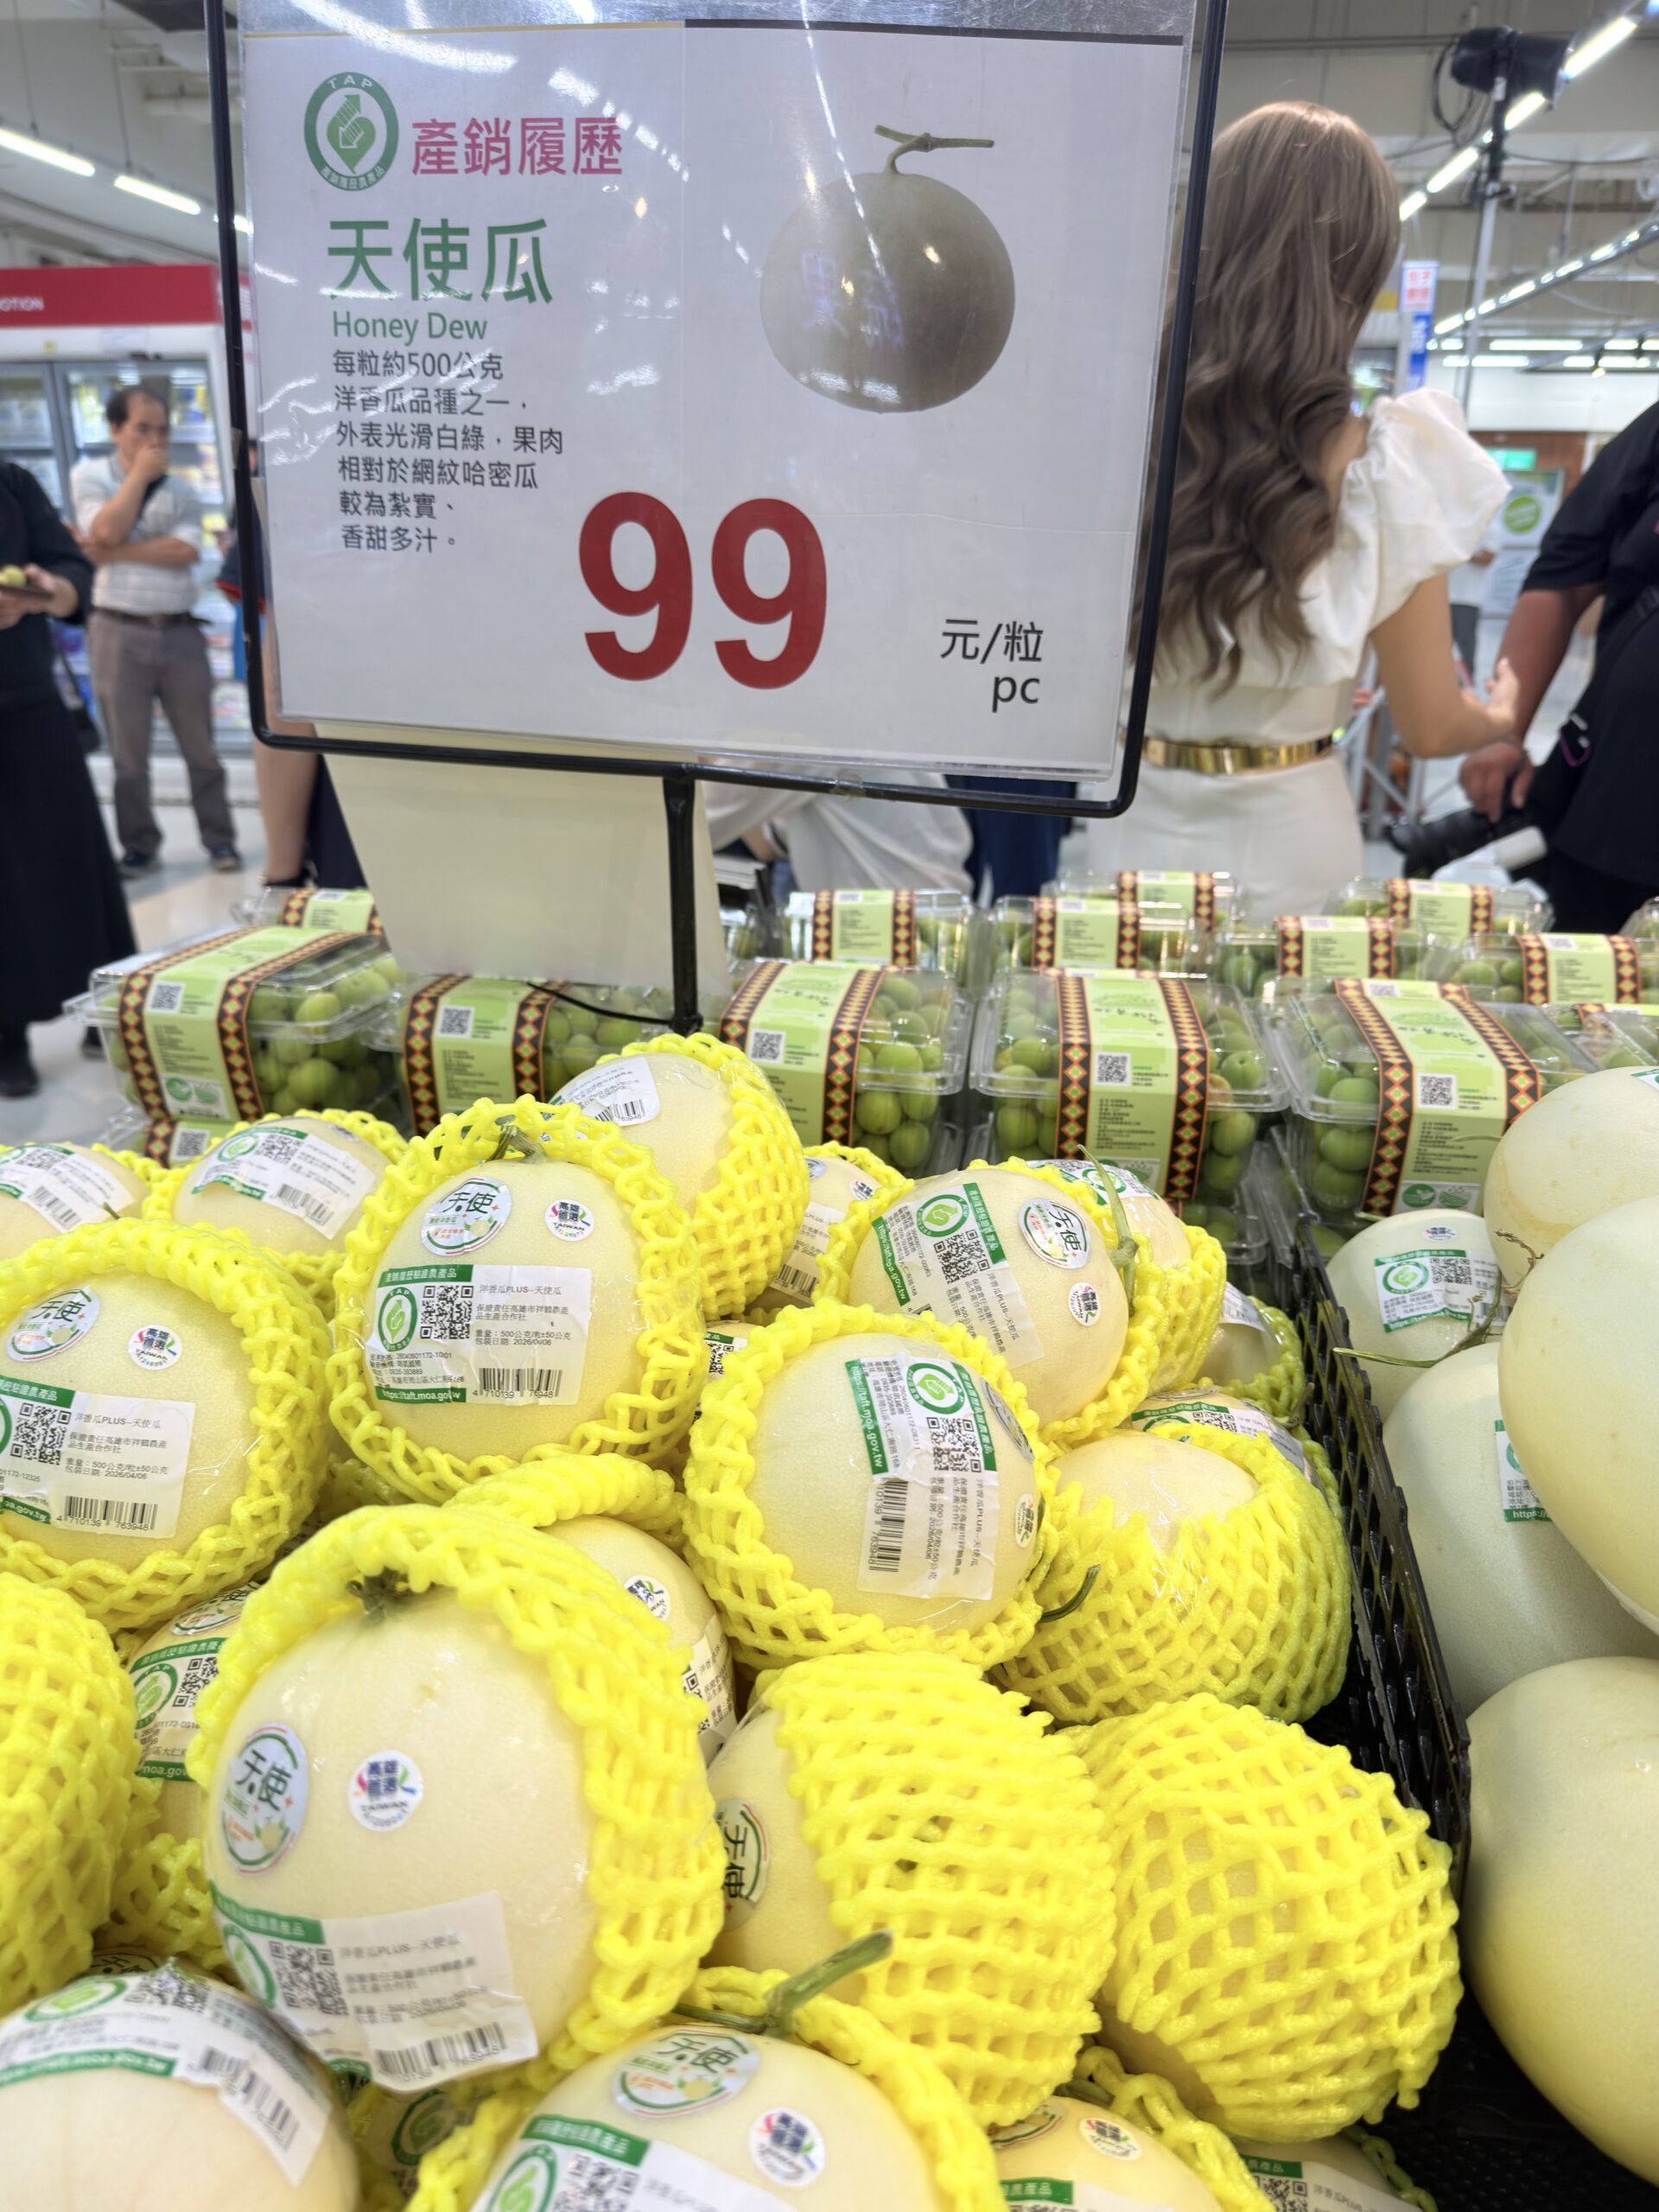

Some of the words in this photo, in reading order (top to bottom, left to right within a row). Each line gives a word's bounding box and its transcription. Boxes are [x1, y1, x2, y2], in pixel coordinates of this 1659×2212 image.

[327, 74, 373, 89] TAP
[411, 117, 623, 175] 產銷履歷
[327, 218, 553, 304] 天使瓜
[333, 311, 418, 346] Honey
[427, 312, 488, 340] Dew
[333, 349, 504, 380] 每粒約500公克
[336, 421, 563, 455] 外表光滑白綠，果肉
[338, 455, 538, 489] 相對於網紋哈密瓜
[341, 524, 455, 553] 香甜多汁。
[578, 492, 827, 690] 99
[940, 619, 1044, 664] 元/粒
[991, 676, 1040, 713] pc
[442, 1191, 496, 1214] 天使
[1048, 1209, 1083, 1253] 天使
[31, 1300, 86, 1323] 天使
[235, 1749, 293, 1812] 天使
[655, 2037, 740, 2074] 天使
